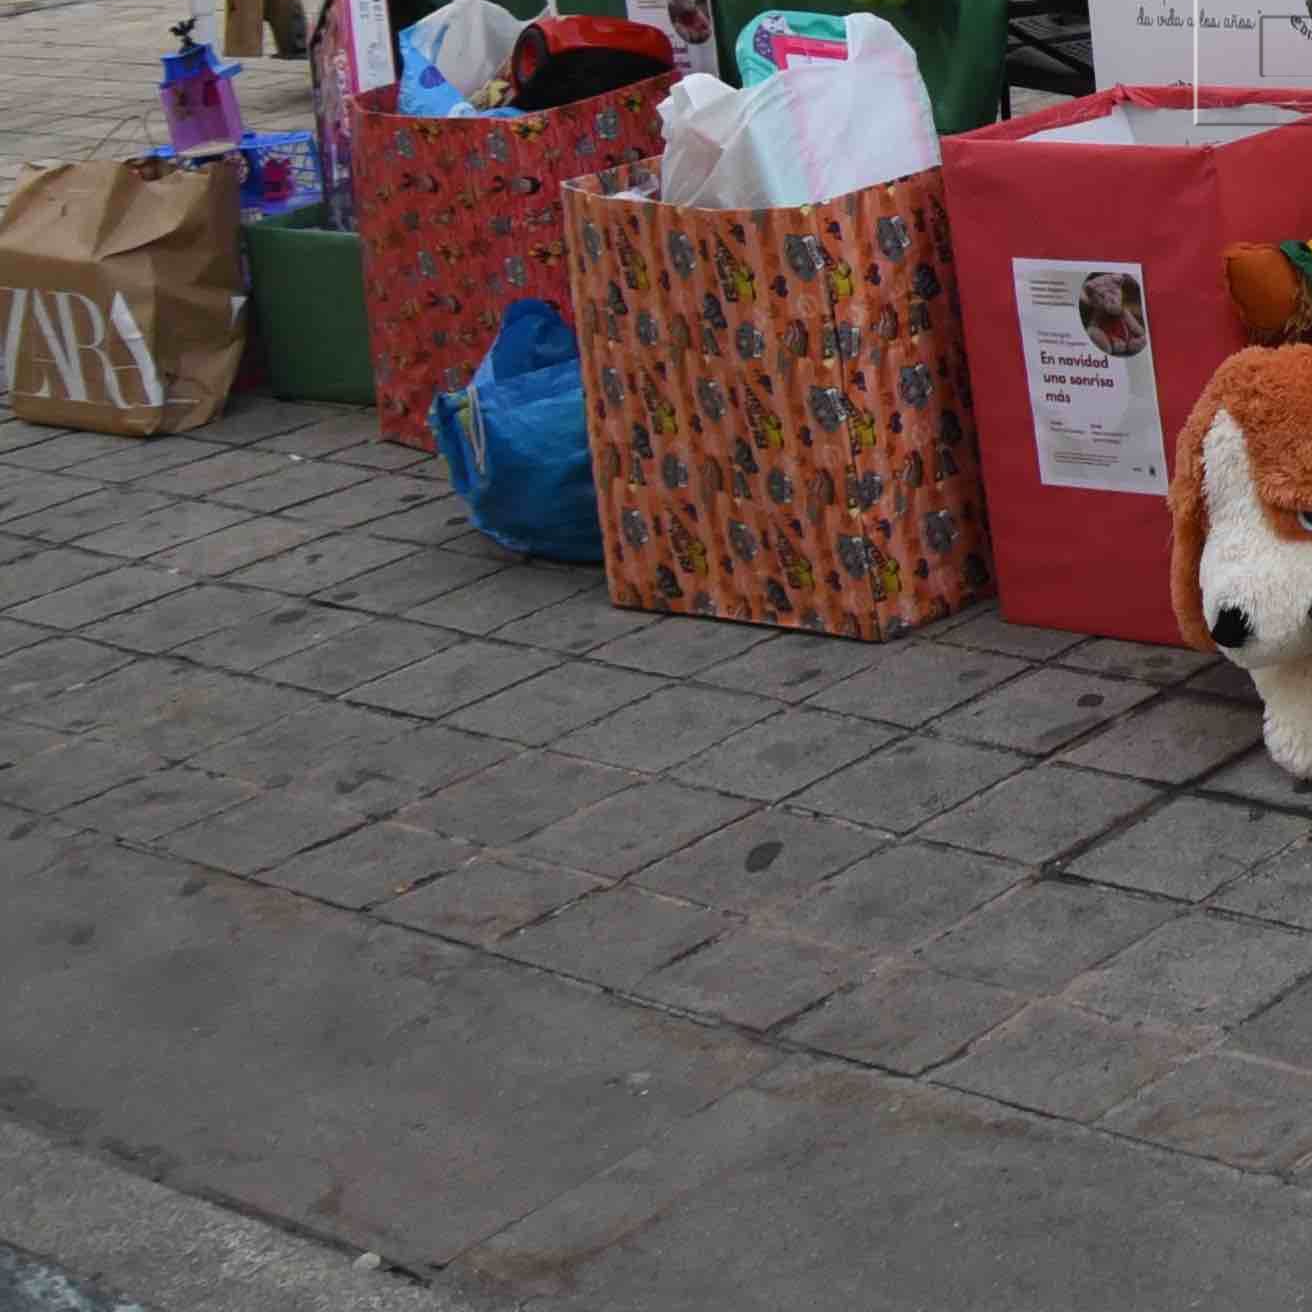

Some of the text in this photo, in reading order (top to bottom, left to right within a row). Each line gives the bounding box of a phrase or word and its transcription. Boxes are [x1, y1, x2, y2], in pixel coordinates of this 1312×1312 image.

[1041, 351, 1108, 369] En navidad
[1044, 373, 1114, 388] una sonrisa
[1046, 390, 1071, 403] más
